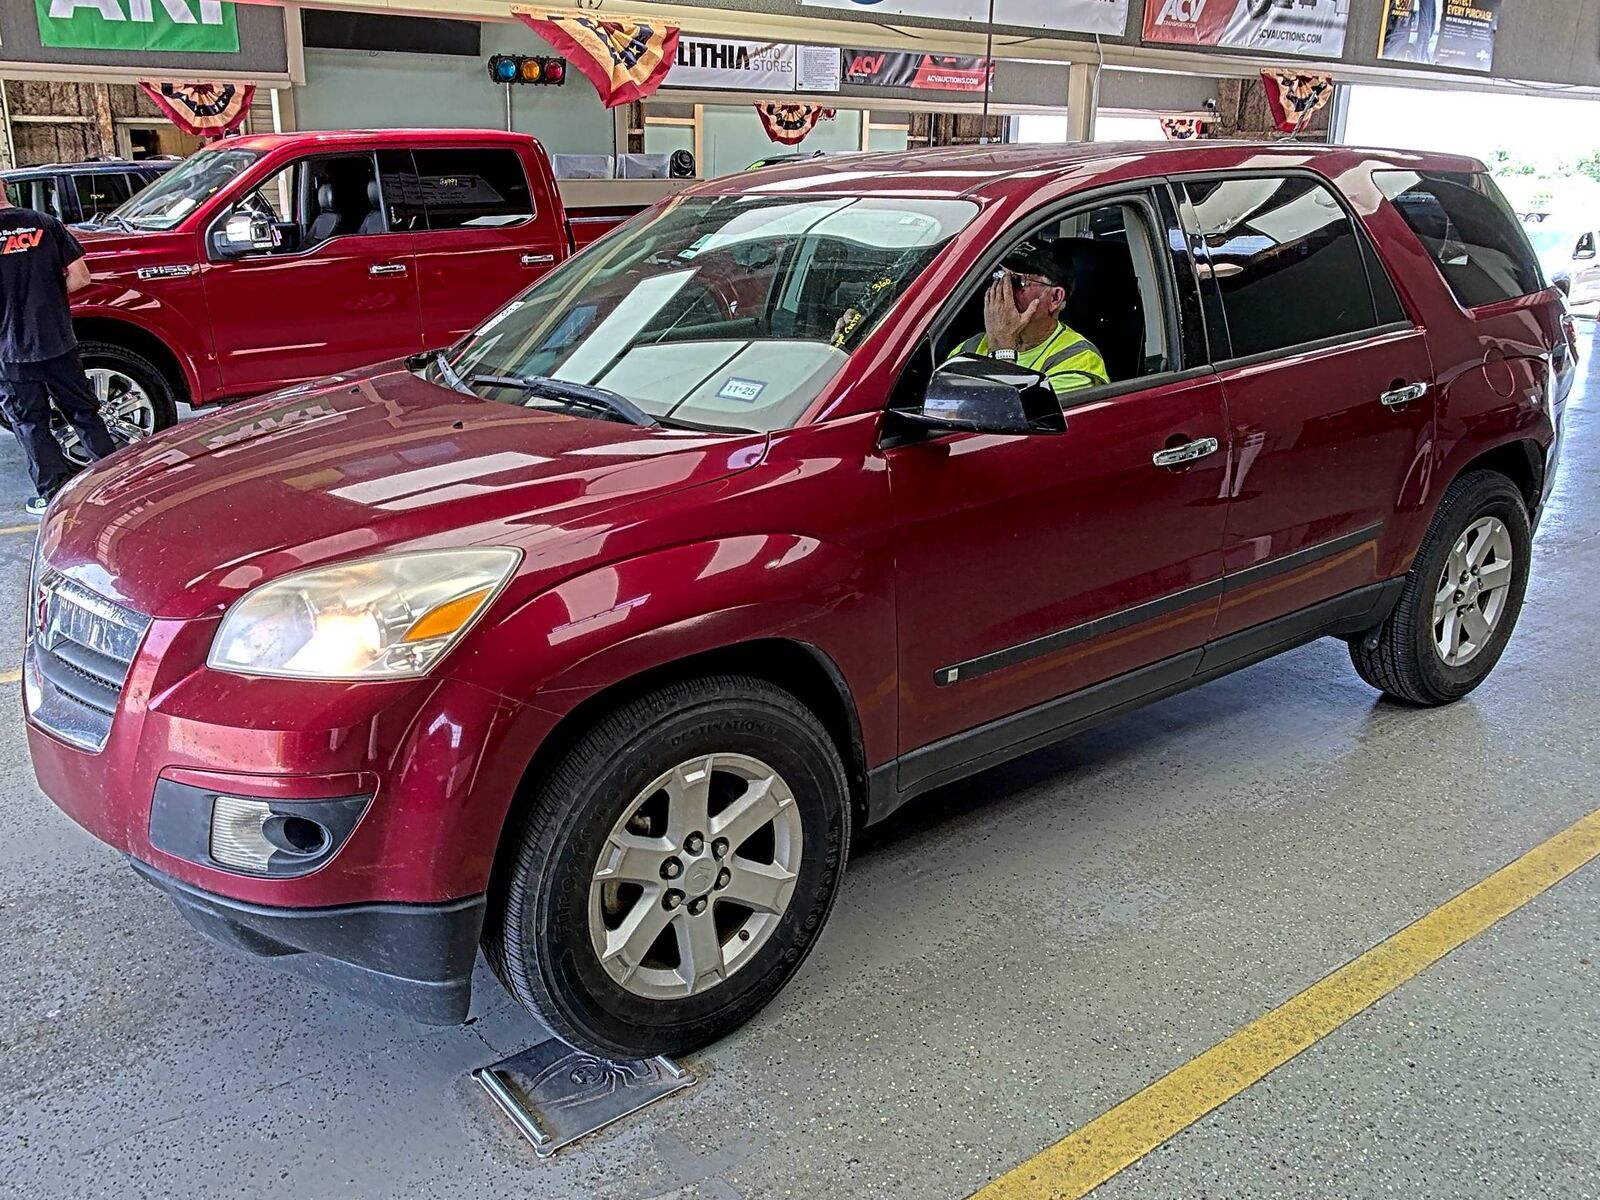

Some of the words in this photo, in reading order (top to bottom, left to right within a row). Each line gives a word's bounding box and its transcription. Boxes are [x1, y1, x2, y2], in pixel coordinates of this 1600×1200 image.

[1259, 29, 1322, 44] CVAUCTIONS.COM
[678, 41, 750, 70] LITHIA
[754, 48, 781, 60] AUTO
[753, 59, 793, 73] STORES
[848, 53, 886, 76] ACV
[926, 75, 979, 85] ACVAUCTIONS.COM
[3, 229, 44, 254] ACV
